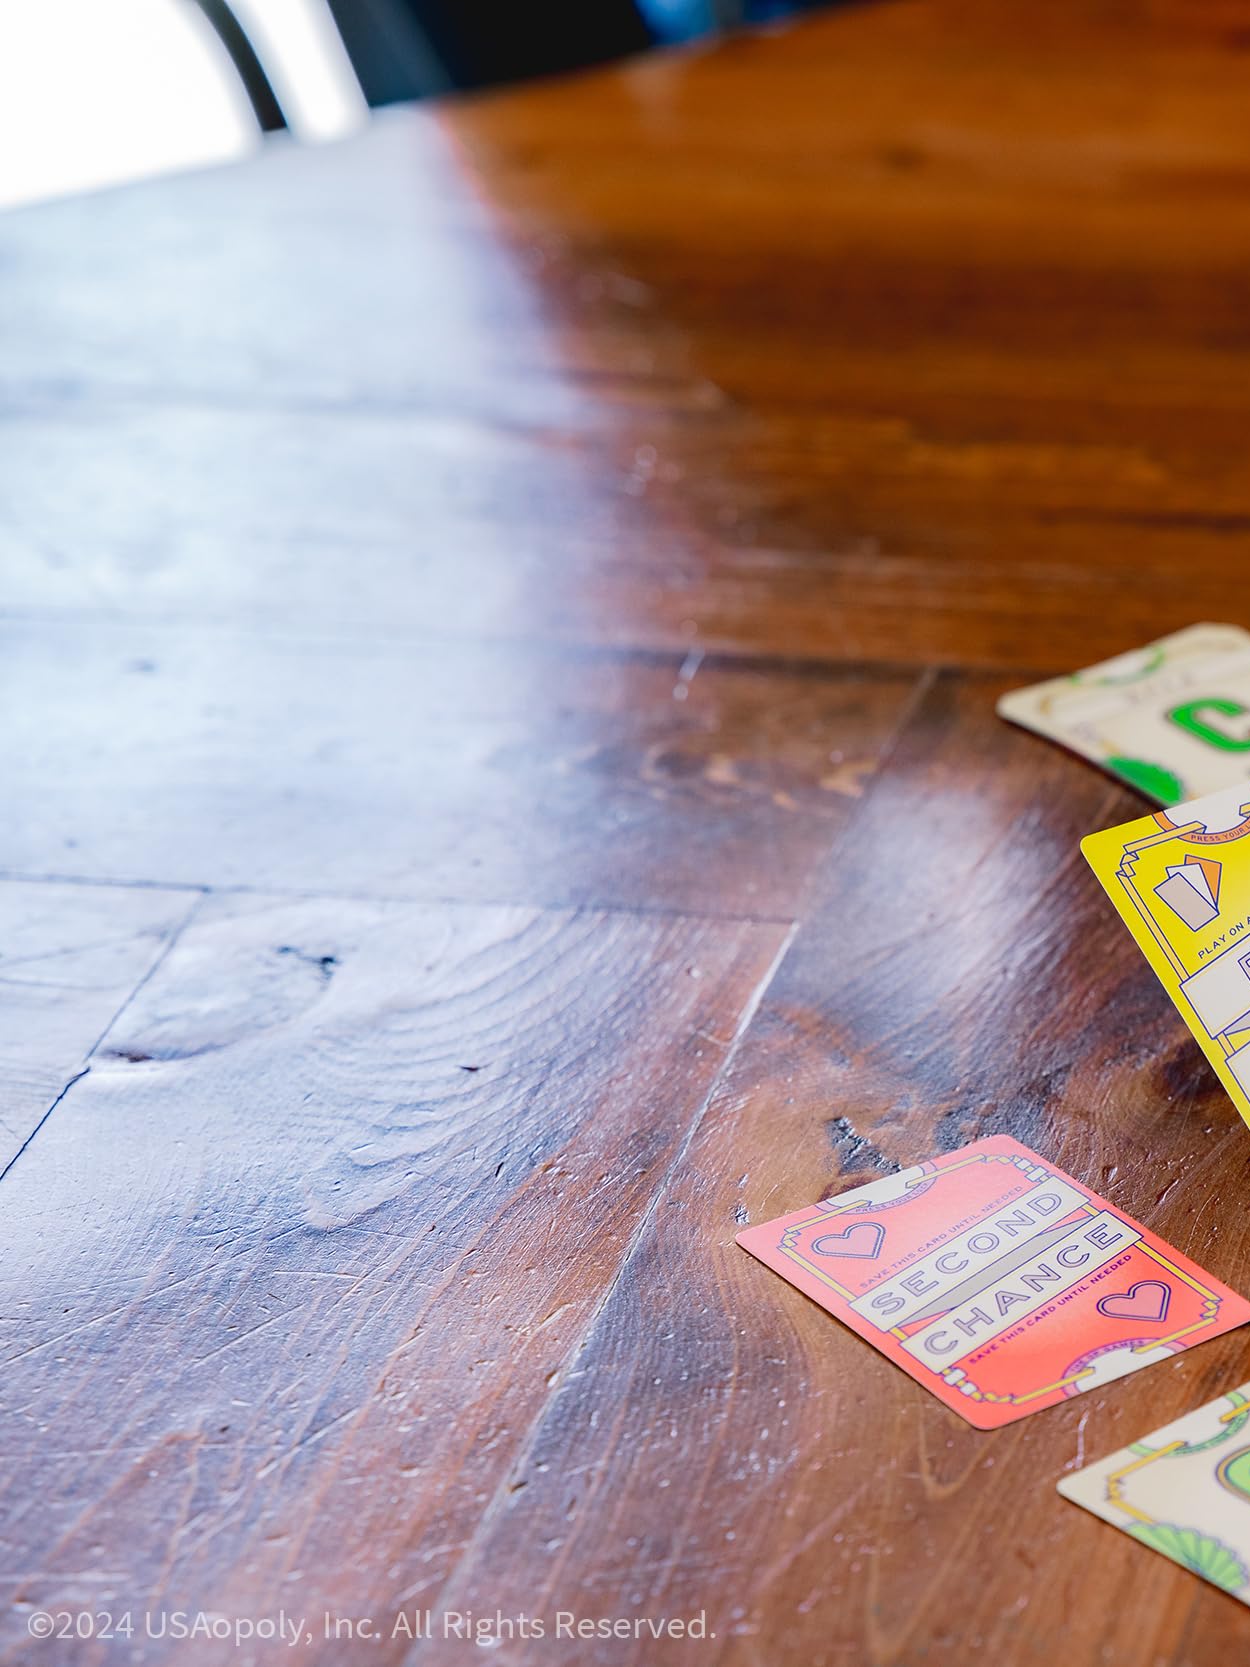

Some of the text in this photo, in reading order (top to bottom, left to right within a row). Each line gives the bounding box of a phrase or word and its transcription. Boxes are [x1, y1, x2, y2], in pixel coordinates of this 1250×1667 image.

[1190, 834, 1221, 842] PRESS
[1223, 828, 1246, 840] YOUR
[1197, 934, 1227, 959] PLAY
[1229, 922, 1245, 936] ON
[859, 1185, 1024, 1289] SAVE THIS CARD UNTIL NEEDED
[871, 1192, 1062, 1316] SECOND
[923, 1222, 1124, 1356] CHANCE
[968, 1254, 1133, 1365] SAVE THIS CARD UNTIL NEEDED
